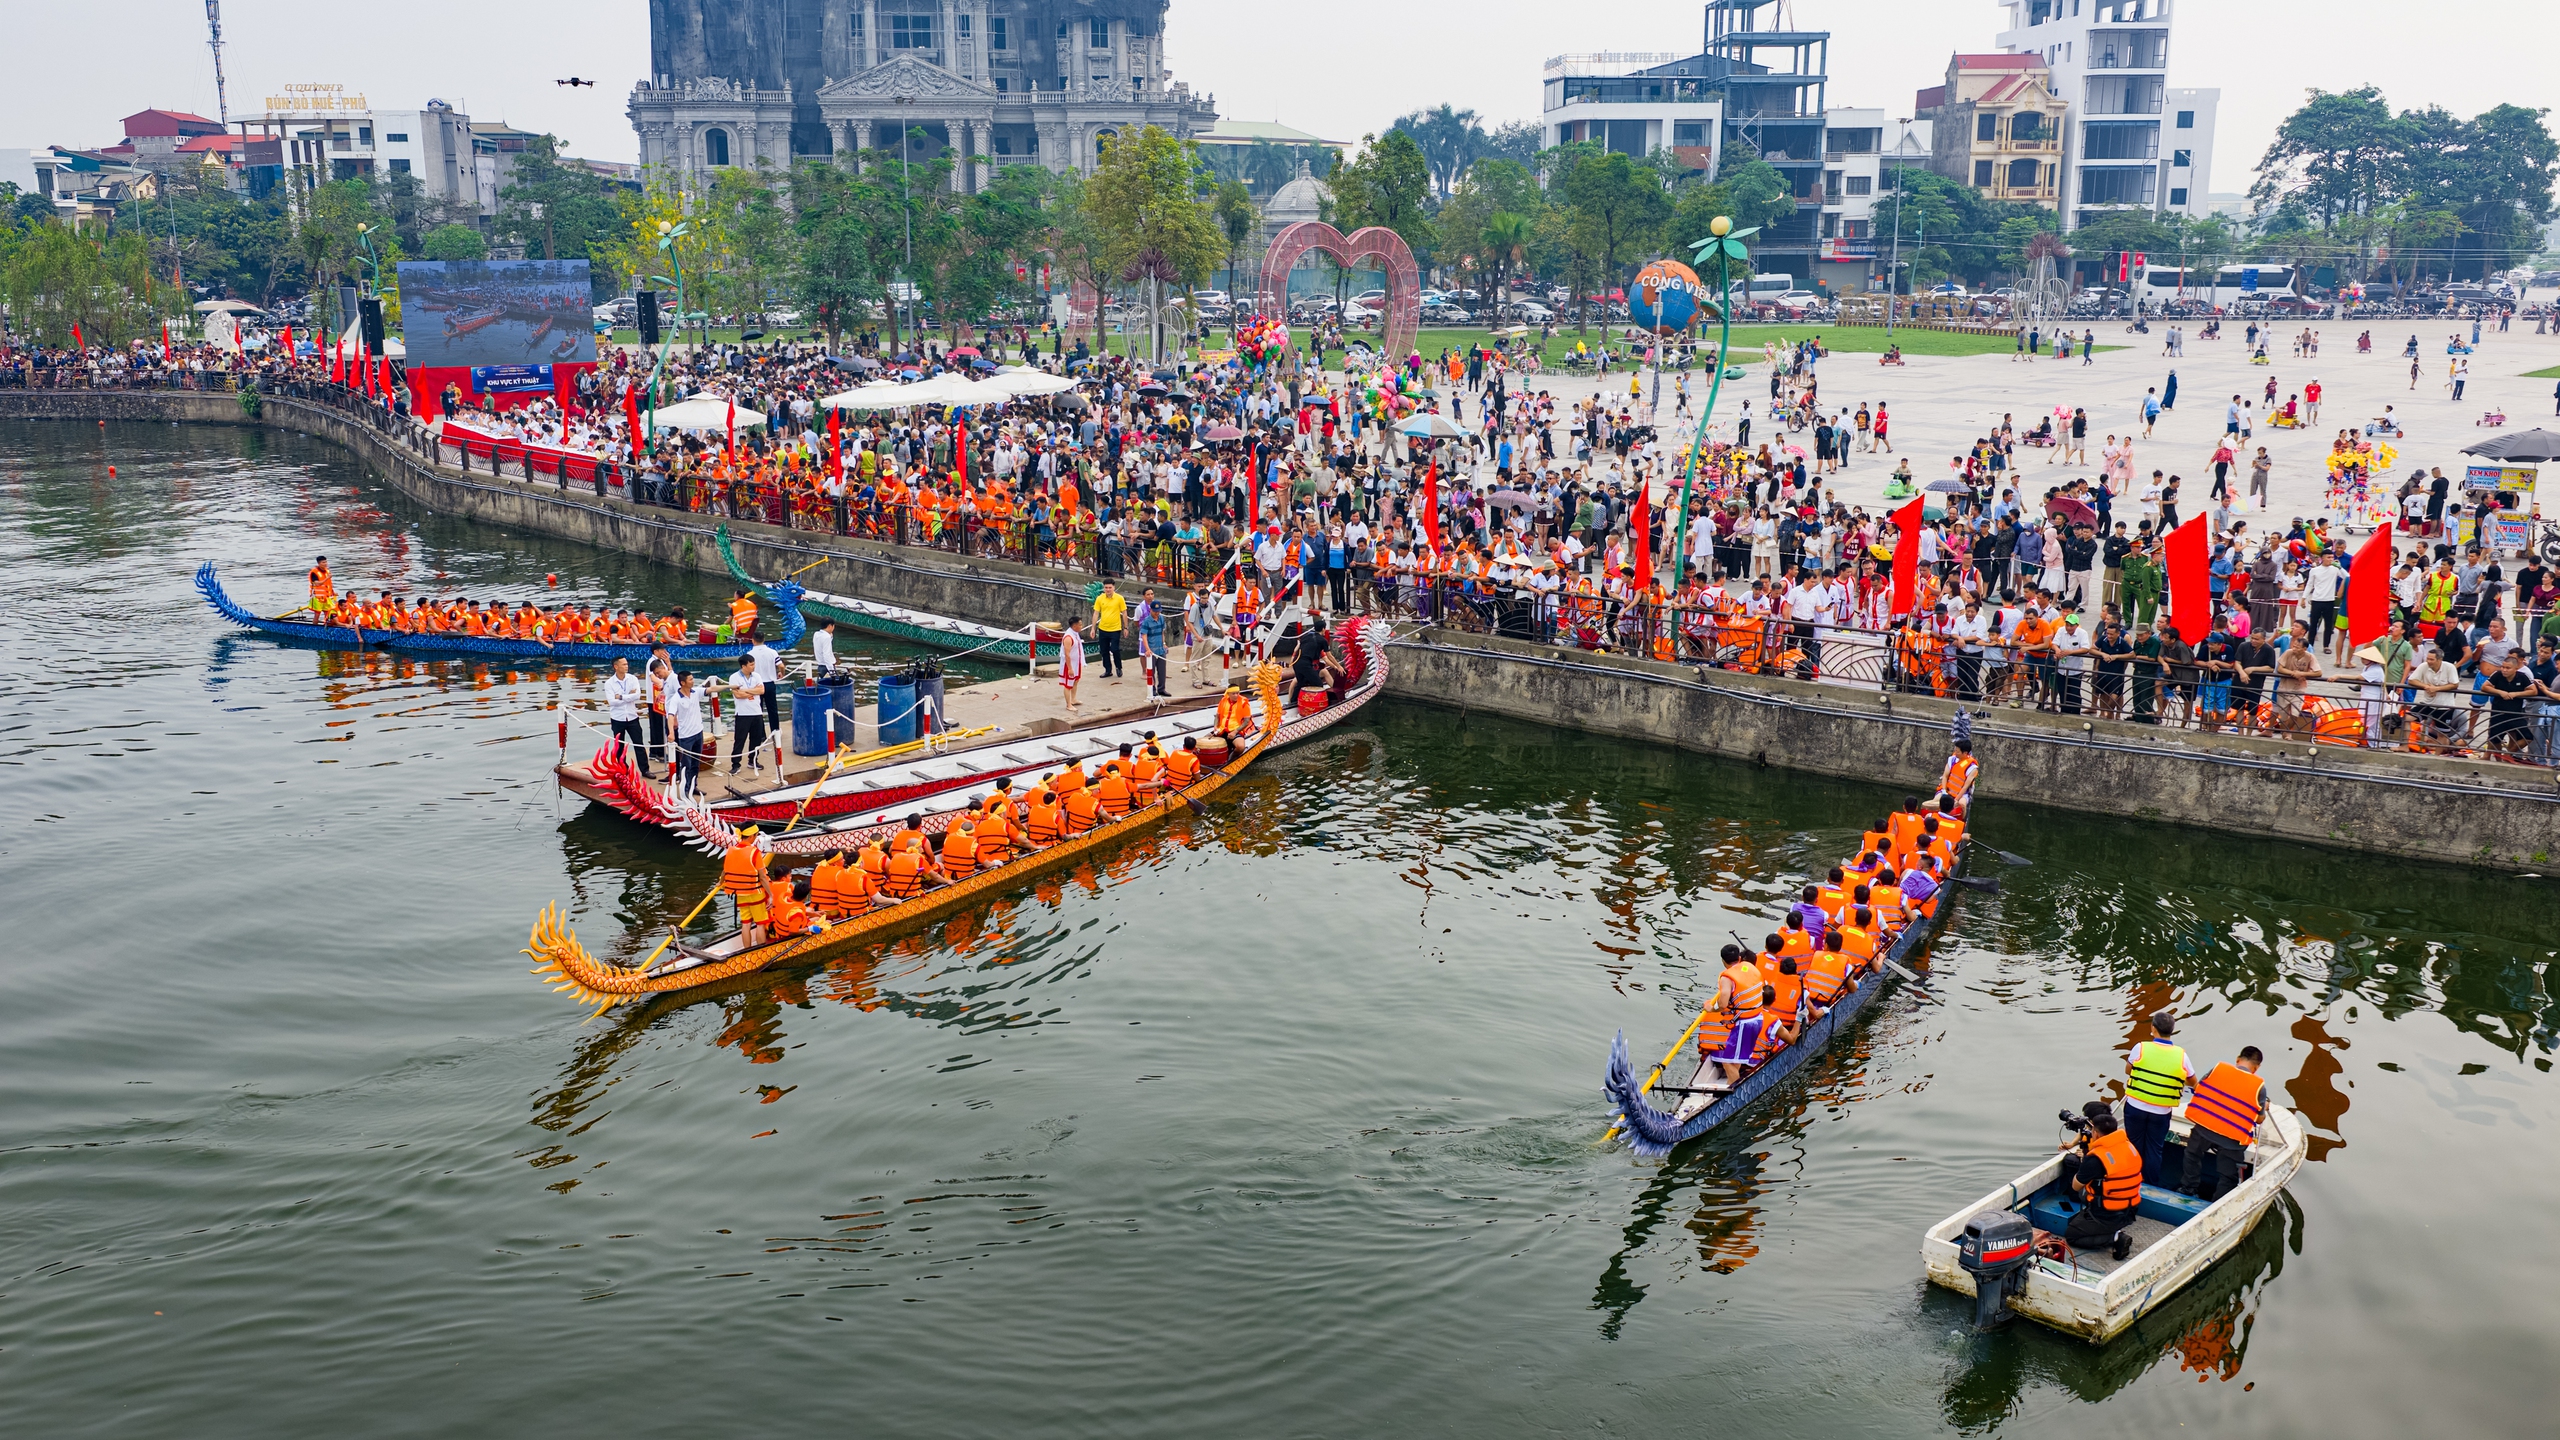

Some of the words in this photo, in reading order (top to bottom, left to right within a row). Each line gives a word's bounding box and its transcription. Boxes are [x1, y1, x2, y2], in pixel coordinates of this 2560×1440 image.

[1624, 52, 1653, 63] COFFEE
[1660, 52, 1675, 63] TEA
[266, 94, 290, 109] BÚN
[294, 94, 308, 109] BÒ
[342, 92, 366, 109] PHỞ
[1641, 272, 1681, 290] CÔNG
[1685, 281, 1712, 301] VIÊN
[500, 379, 512, 387] VỰC
[522, 377, 540, 385] THUẬT
[2469, 469, 2483, 477] KEM
[1963, 1242, 1975, 1252] 40
[1987, 1238, 2017, 1251] YAMAHA
